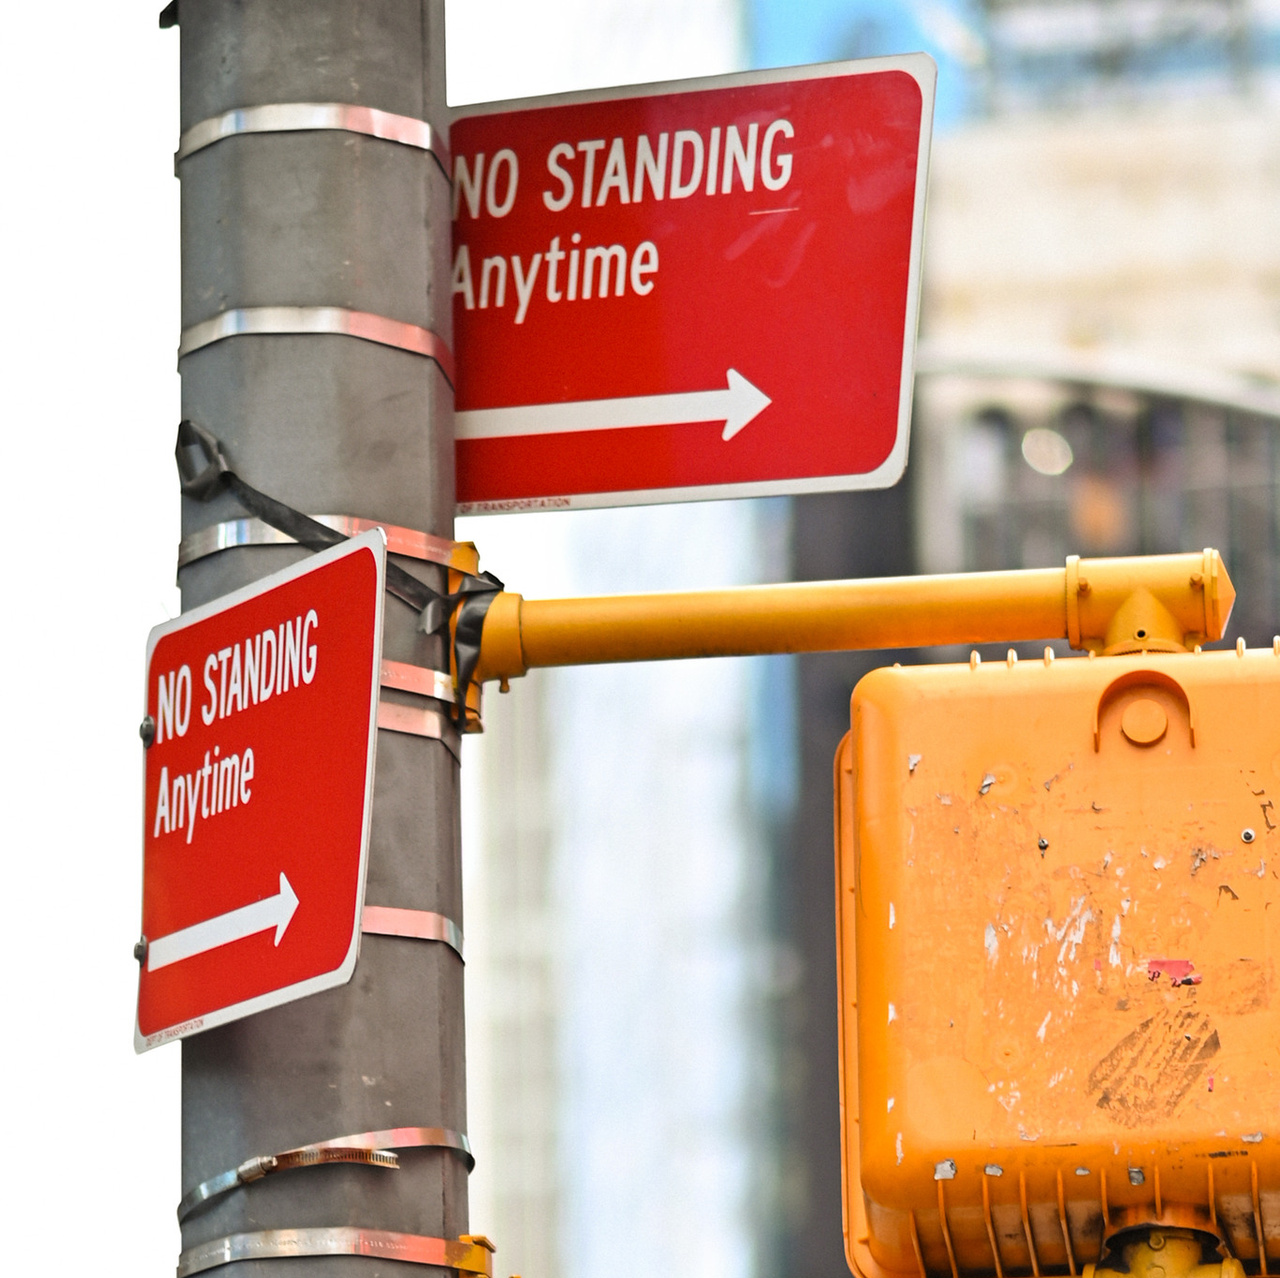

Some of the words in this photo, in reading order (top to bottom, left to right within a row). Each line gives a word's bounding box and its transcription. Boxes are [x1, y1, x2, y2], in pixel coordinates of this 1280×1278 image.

[451, 147, 520, 221] NO
[542, 118, 795, 212] STANDING
[451, 234, 660, 324] Anytime
[477, 498, 570, 511] TRANSPORTATION
[156, 663, 192, 744] NO
[202, 609, 319, 726] STANDING
[153, 747, 254, 845] Anytime
